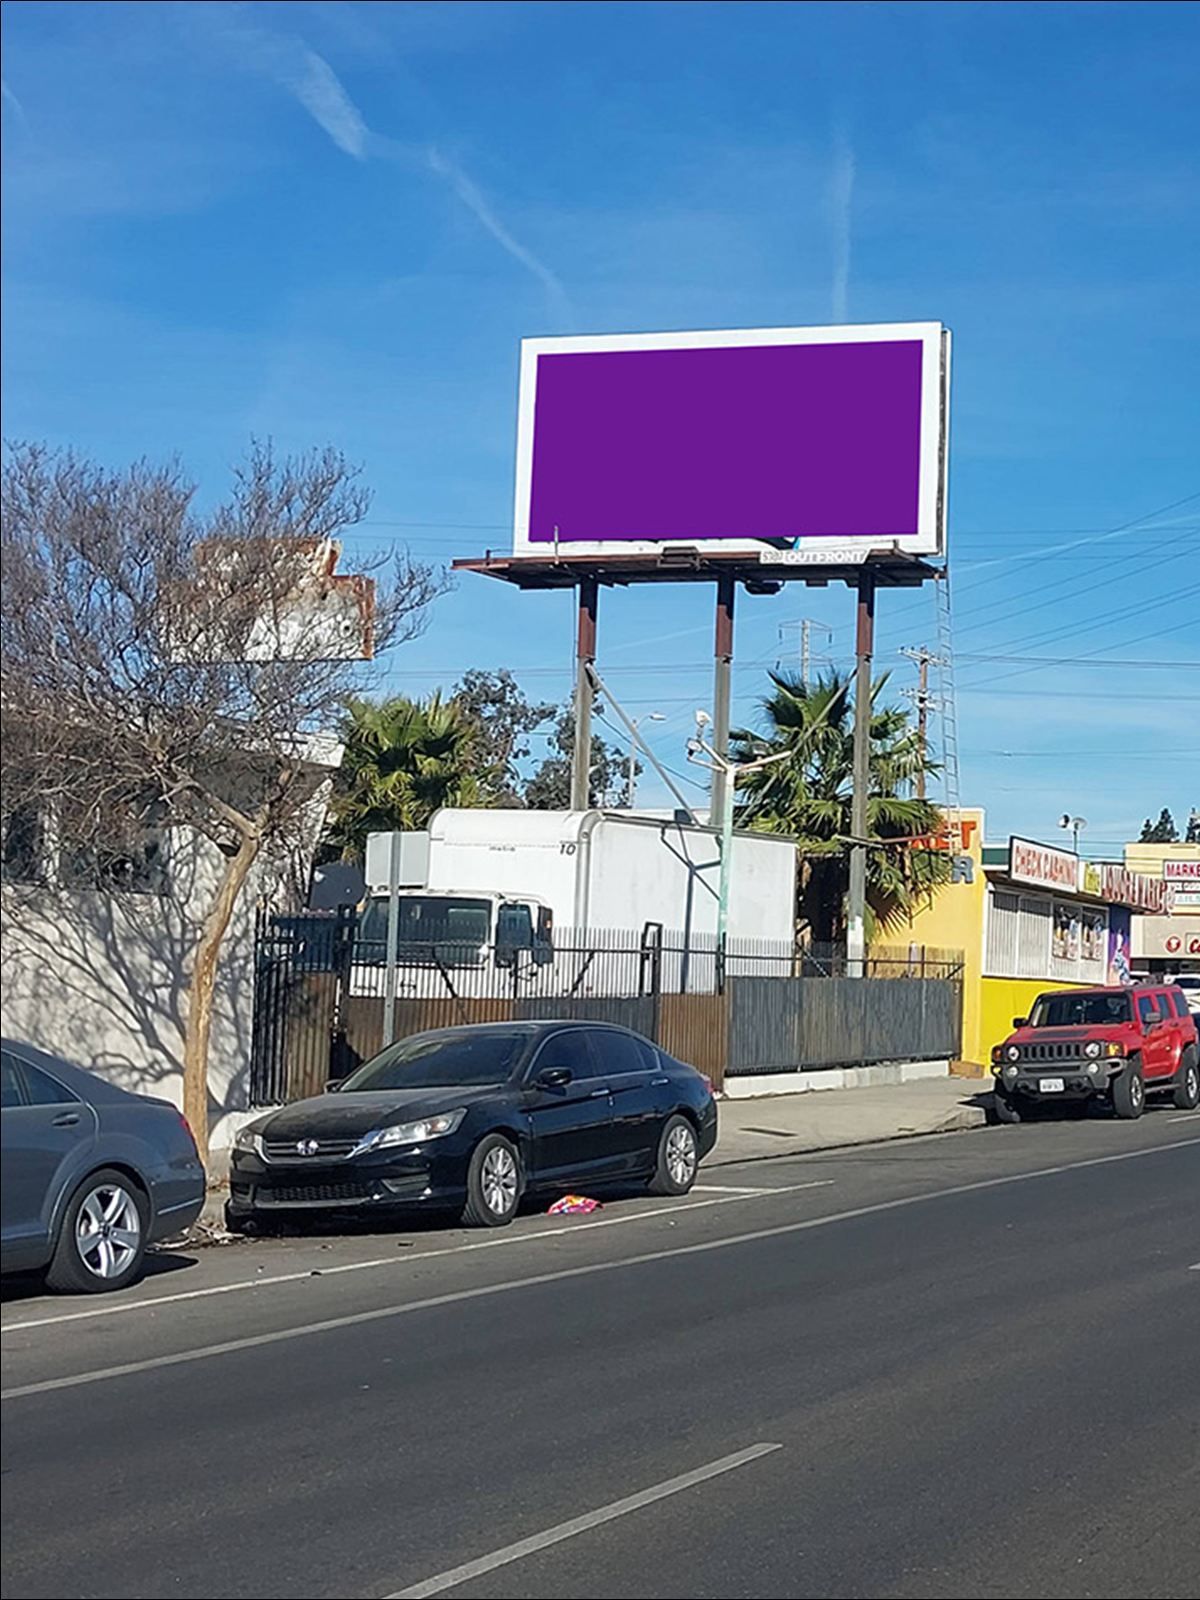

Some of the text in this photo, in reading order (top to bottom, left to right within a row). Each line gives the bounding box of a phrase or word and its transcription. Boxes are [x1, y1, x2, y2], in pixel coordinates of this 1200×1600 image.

[787, 551, 864, 562] OUTFRONT
[560, 843, 577, 856] 10
[1014, 845, 1042, 878] CHECK
